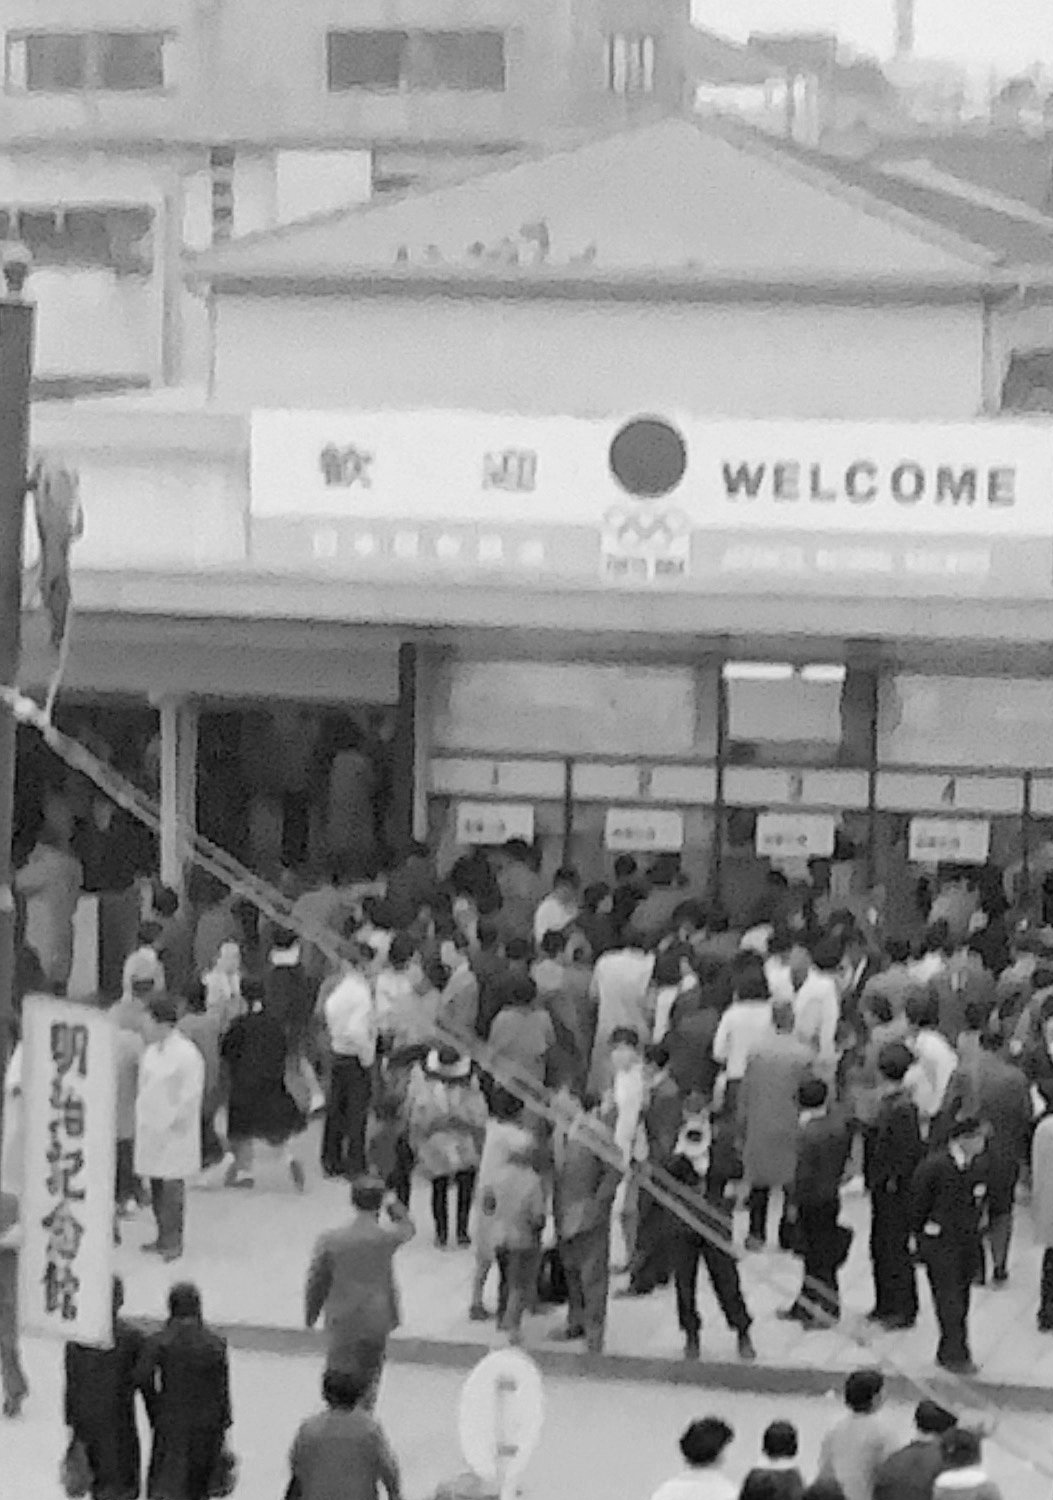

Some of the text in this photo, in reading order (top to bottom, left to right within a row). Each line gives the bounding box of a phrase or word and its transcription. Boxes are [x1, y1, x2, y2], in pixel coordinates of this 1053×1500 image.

[721, 460, 1016, 506] WELCOME
[42, 1021, 90, 1323] 明治記念館
